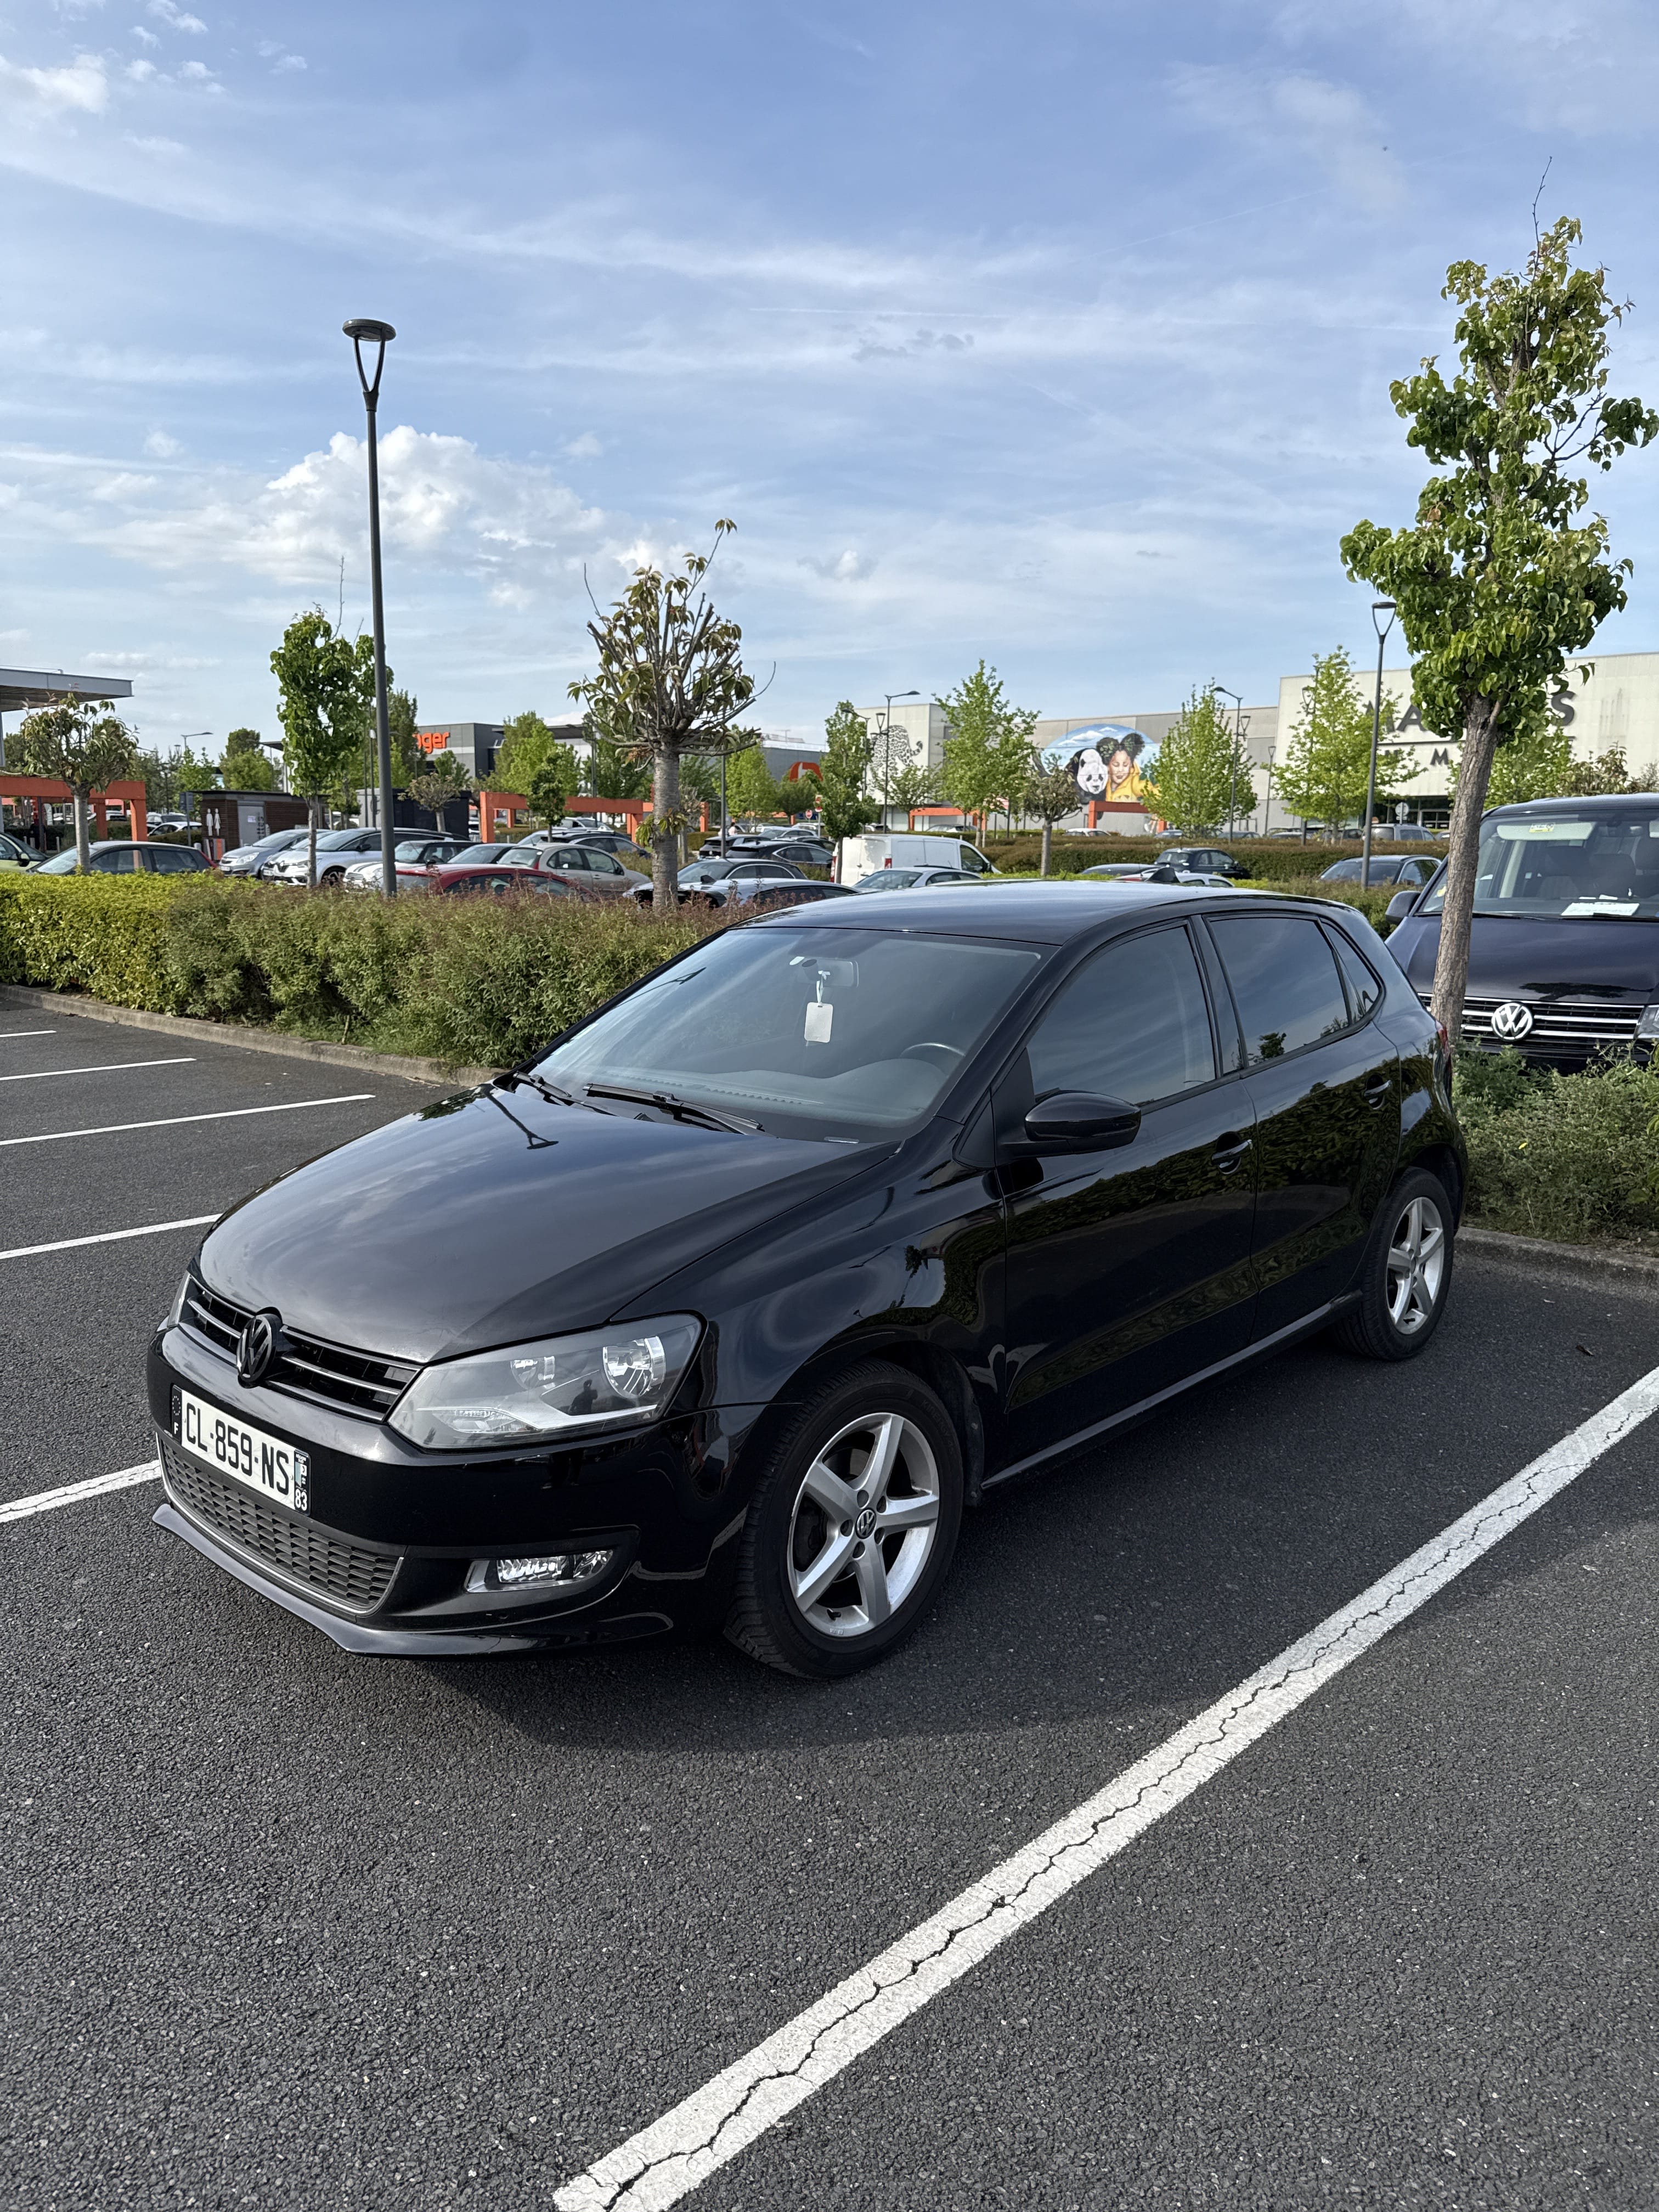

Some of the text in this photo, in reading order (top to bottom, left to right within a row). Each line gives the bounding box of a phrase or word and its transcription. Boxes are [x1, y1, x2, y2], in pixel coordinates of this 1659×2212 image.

[174, 1422, 178, 1435] F
[186, 1402, 289, 1495] CL-859-NS
[295, 1488, 307, 1511] 83
